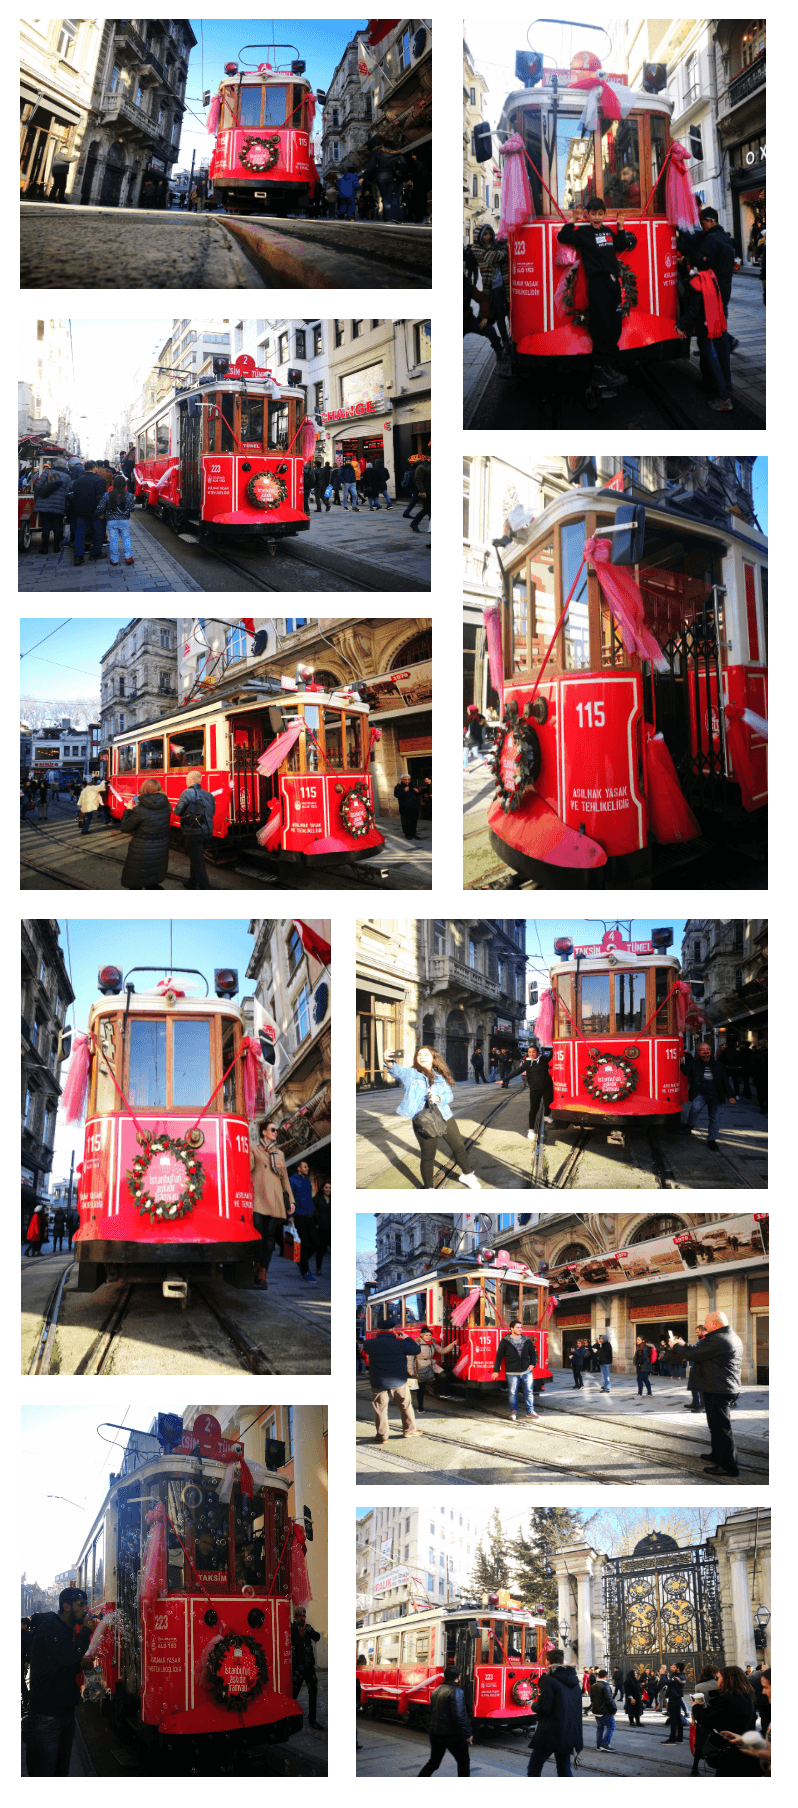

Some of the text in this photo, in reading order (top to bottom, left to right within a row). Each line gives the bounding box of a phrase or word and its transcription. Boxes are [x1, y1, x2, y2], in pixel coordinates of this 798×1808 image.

[583, 53, 590, 68] 2
[298, 137, 308, 147] 115
[514, 240, 526, 255] 223
[243, 355, 248, 365] 2
[211, 464, 221, 473] 223
[575, 701, 605, 728] 115
[300, 786, 317, 799] 115
[572, 785, 628, 799] ASILMAK YASAK
[570, 800, 579, 811] VE
[608, 931, 615, 942] 4
[626, 942, 653, 953] TÜNEL
[554, 1050, 564, 1061] 115
[665, 1048, 678, 1060] 115
[87, 1133, 102, 1152] 115
[235, 1134, 249, 1154] 115
[479, 1336, 491, 1345] 115
[204, 1416, 211, 1433] 2
[198, 1573, 227, 1582] TAKSİM
[155, 1614, 169, 1630] 223
